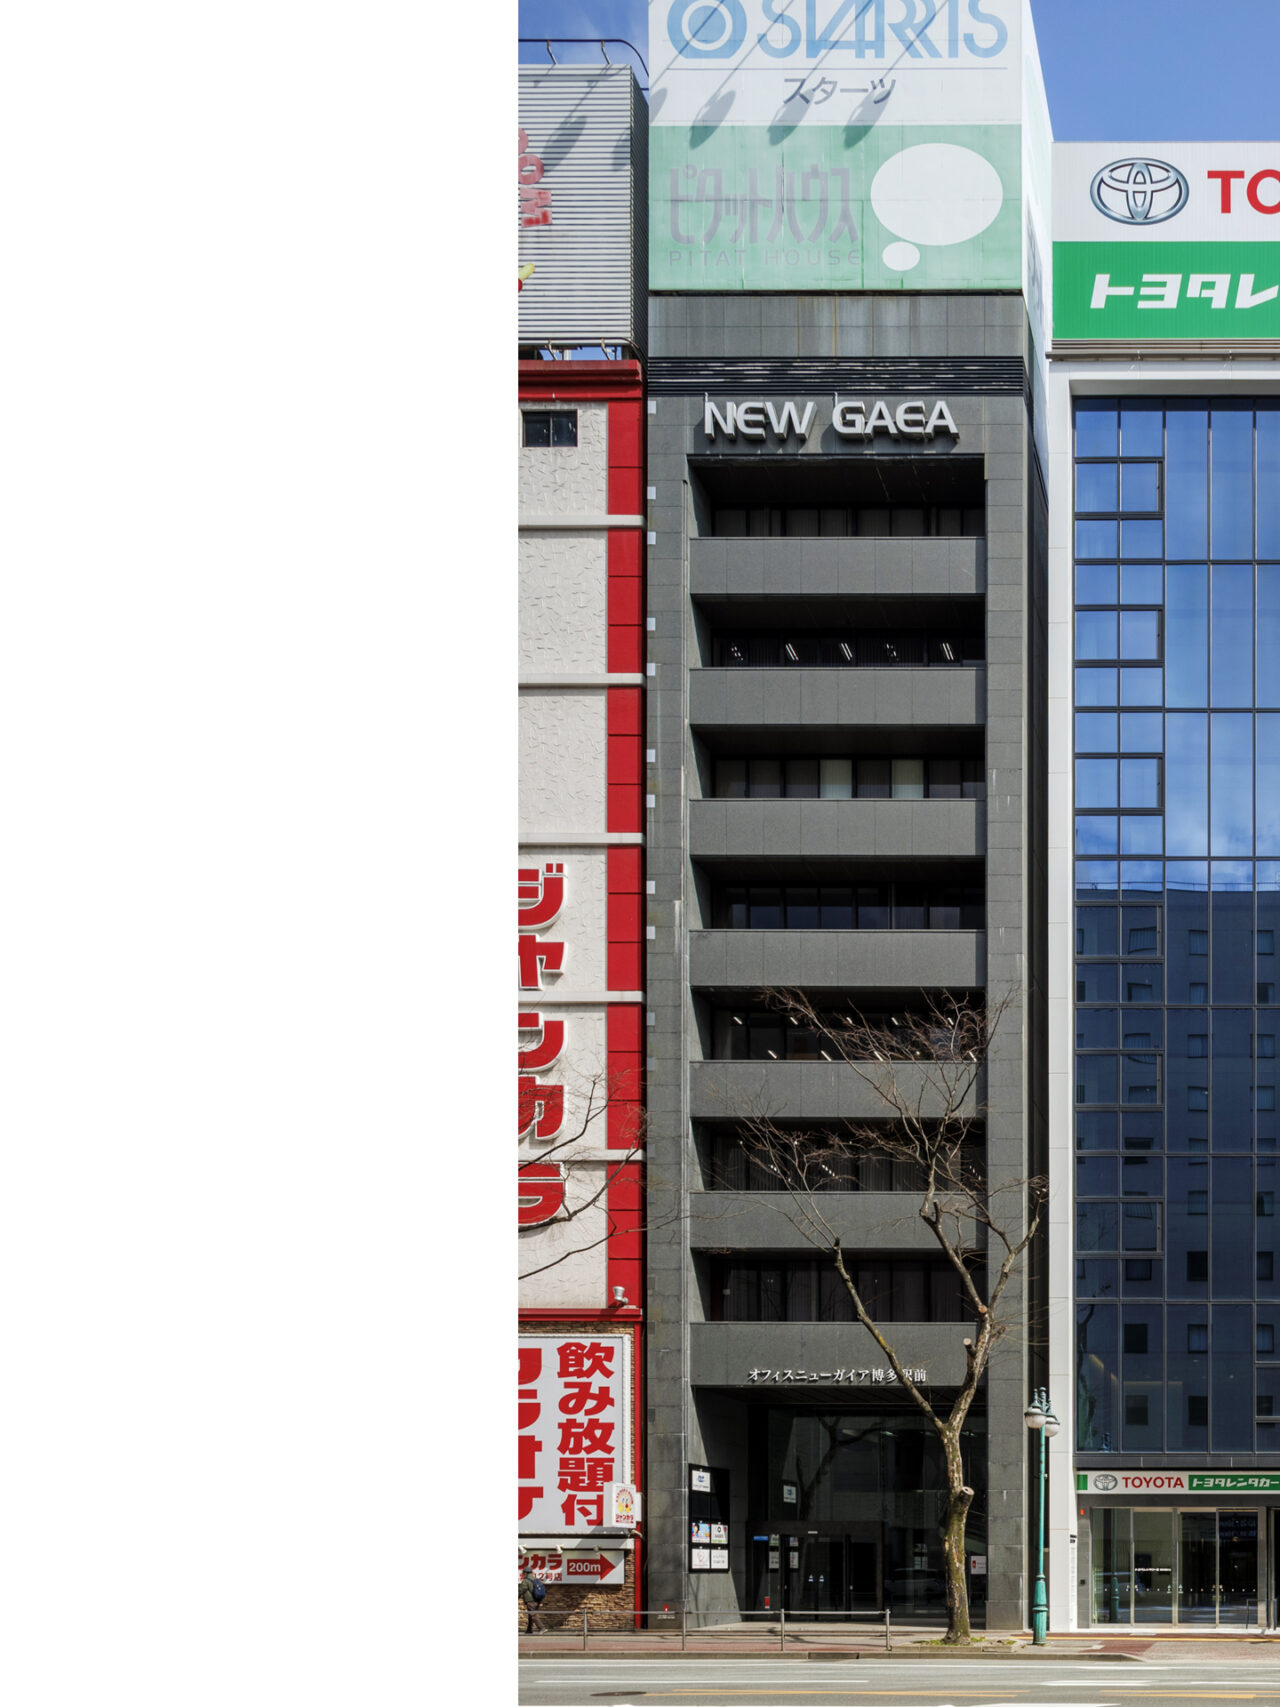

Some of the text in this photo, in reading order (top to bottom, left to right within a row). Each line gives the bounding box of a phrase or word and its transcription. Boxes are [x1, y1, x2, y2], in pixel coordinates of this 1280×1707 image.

[783, 76, 897, 105] スターツ
[669, 164, 858, 244] ピタットハウス
[669, 249, 861, 266] PITAT HOUSE
[704, 401, 958, 440] NEW GAEA
[557, 1342, 615, 1526] 飲み放題付
[1122, 1476, 1185, 1489] TOYOTA
[1192, 1477, 1280, 1488] トヨタレンタカー
[568, 1562, 600, 1572] 200m
